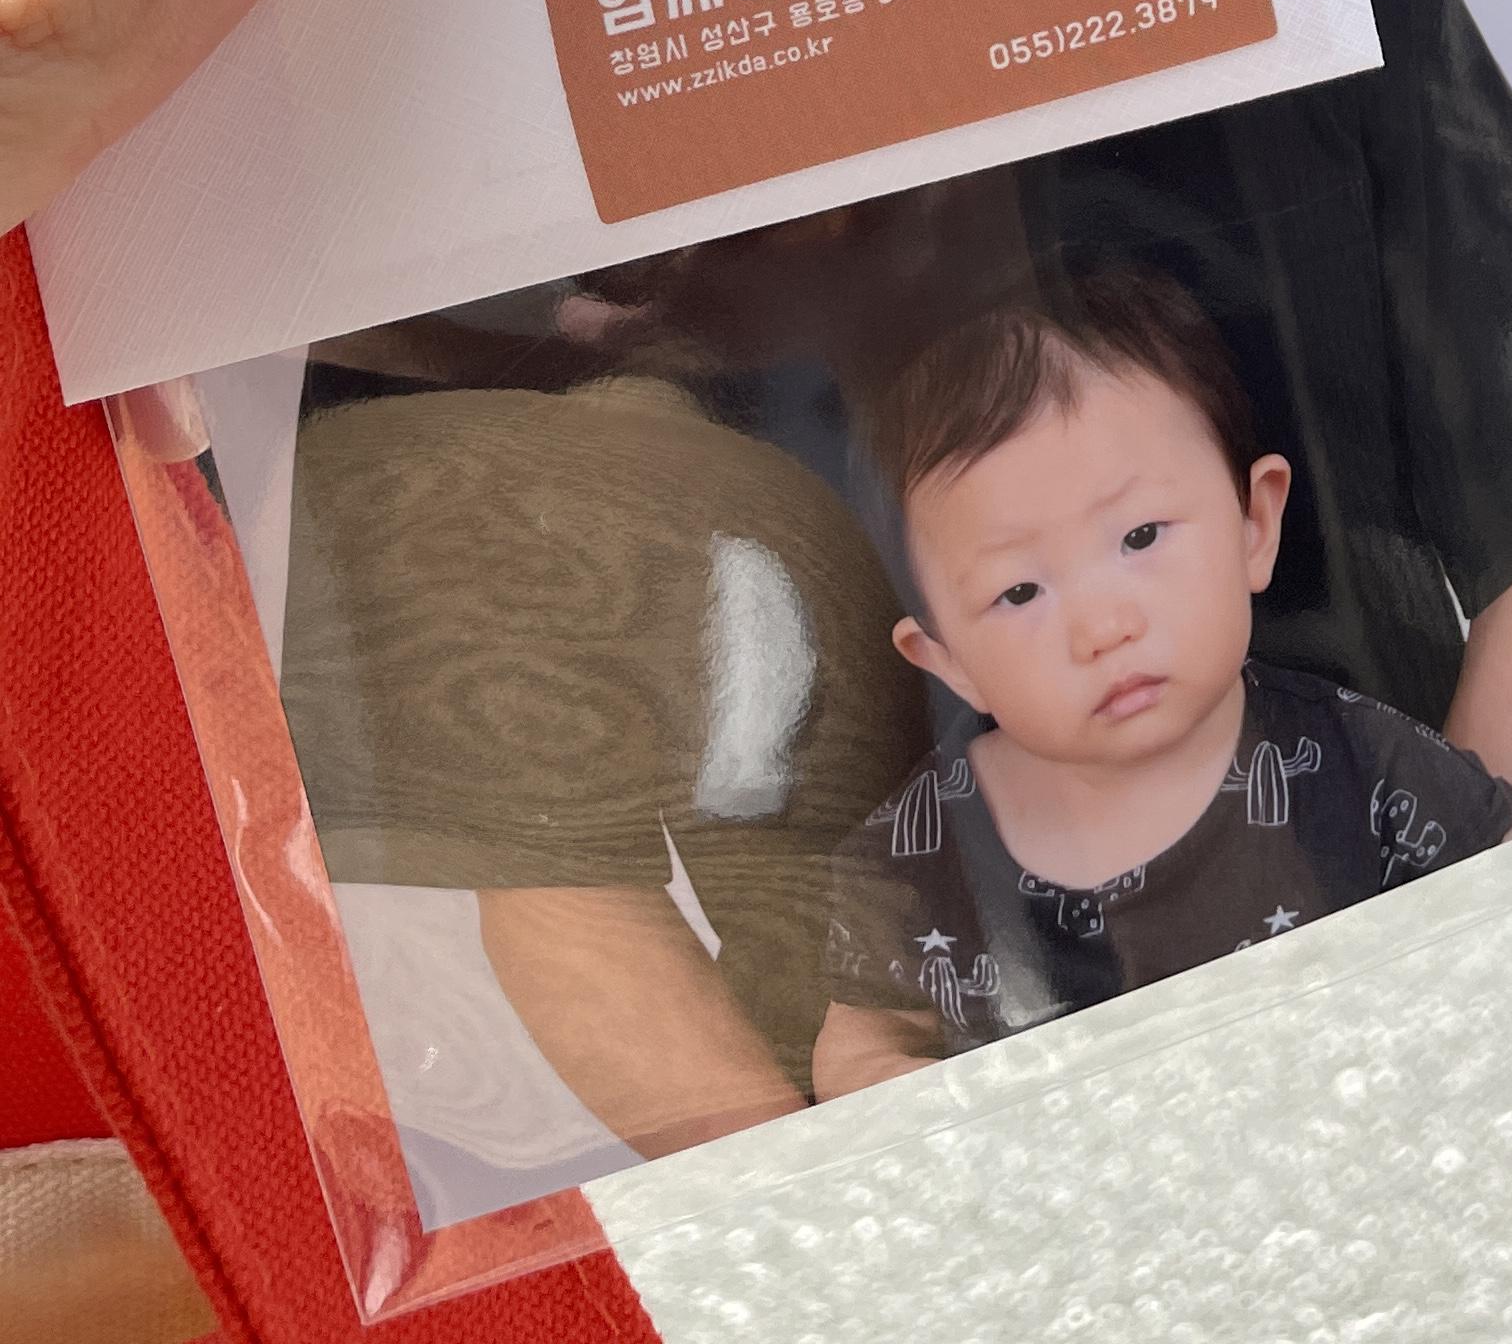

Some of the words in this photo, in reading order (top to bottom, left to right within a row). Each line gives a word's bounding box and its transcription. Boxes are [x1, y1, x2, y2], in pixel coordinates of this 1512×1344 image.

[608, 33, 689, 77] 창원시
[700, 9, 779, 52] 성산구
[617, 36, 833, 107] www.zzikda.co.kr
